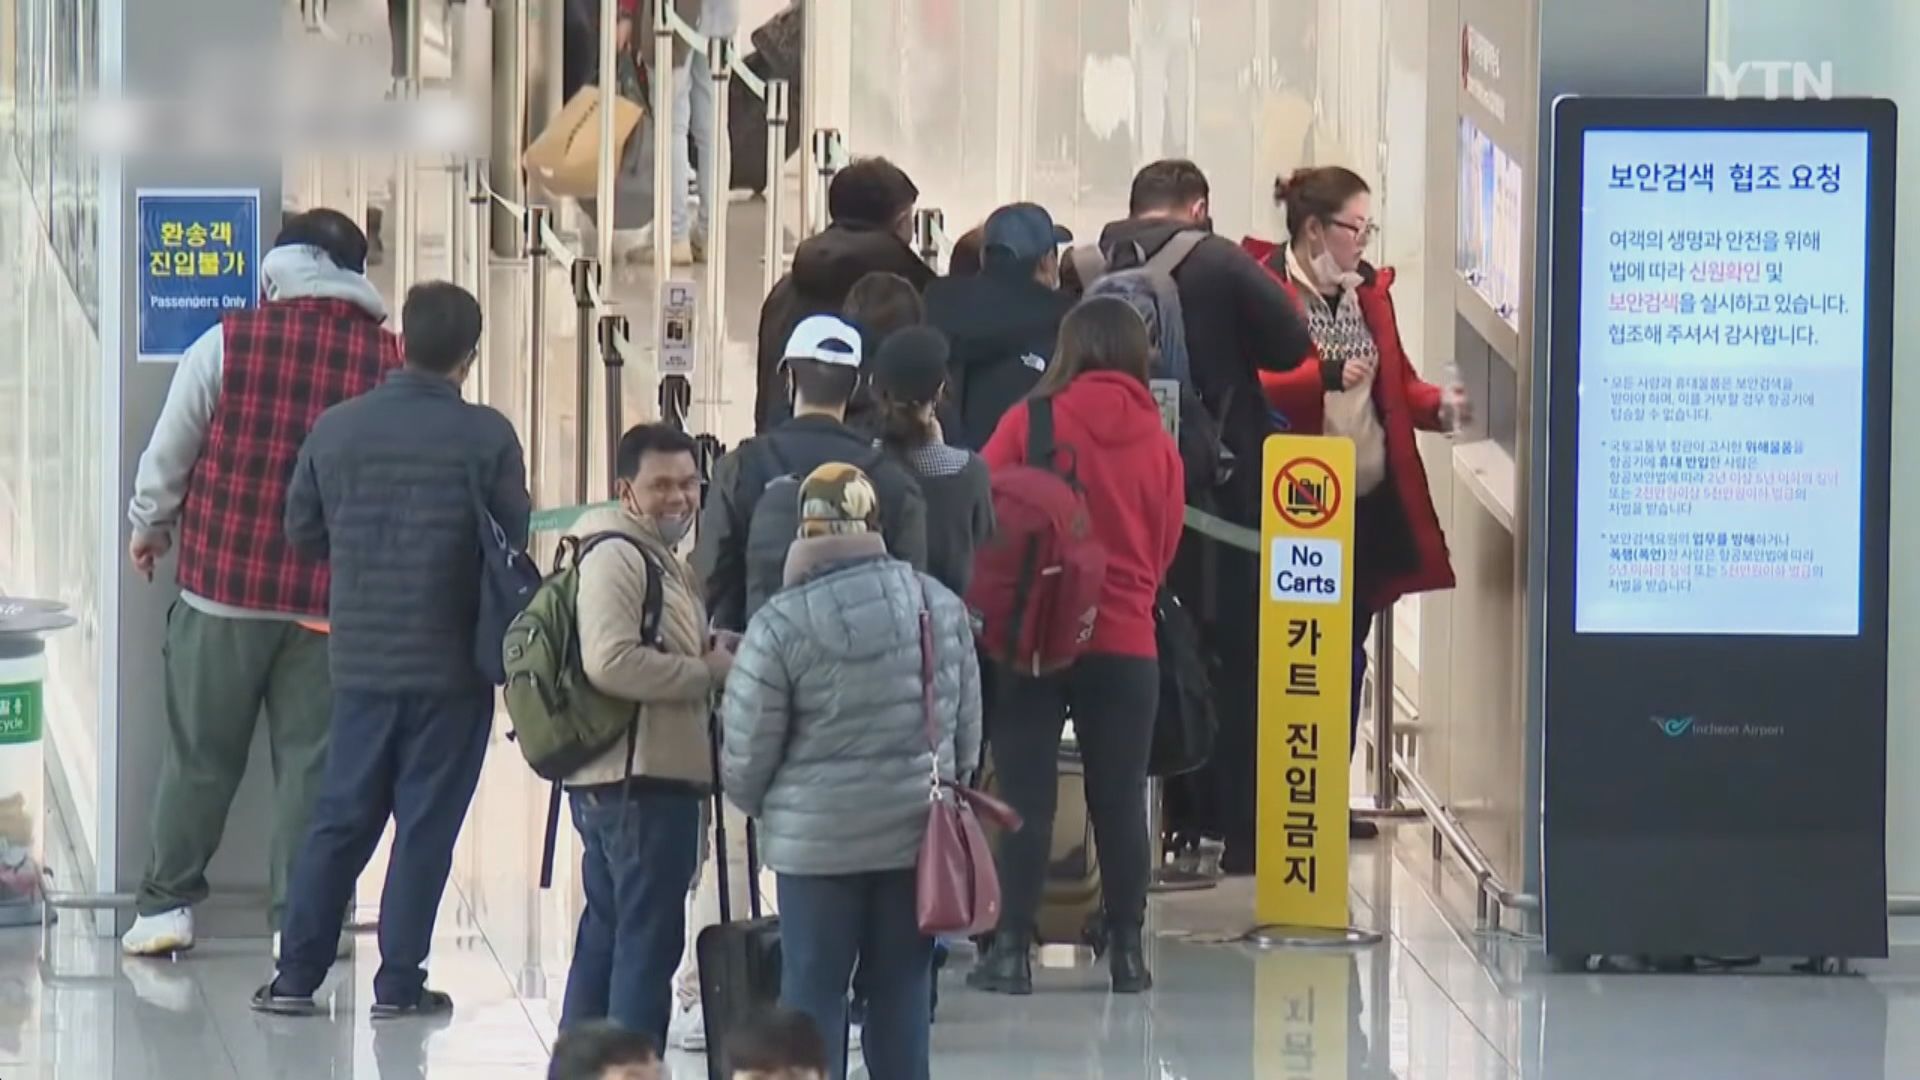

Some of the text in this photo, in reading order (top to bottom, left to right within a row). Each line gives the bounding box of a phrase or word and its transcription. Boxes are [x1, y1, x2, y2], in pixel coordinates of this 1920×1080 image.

[1608, 162, 1841, 194] 보안검색 협조 요청
[161, 222, 231, 247] 환송객
[1609, 230, 1821, 251] 여객의 생명과 안전을 위해
[150, 251, 245, 276] 진입불가
[1609, 261, 1783, 283] 법에 따라 신원확인 및
[151, 296, 246, 309] Passengers Only
[1608, 292, 1849, 314] 보안검색을 실시하고 있습니다.
[1608, 323, 1819, 345] 협조해 주셔서 감사합니다.
[1292, 544, 1323, 567] No
[1277, 571, 1336, 593] Carts
[1285, 618, 1322, 696] 카트
[1692, 722, 1784, 737] Incheon Airport
[1283, 723, 1318, 893] 진입금지
